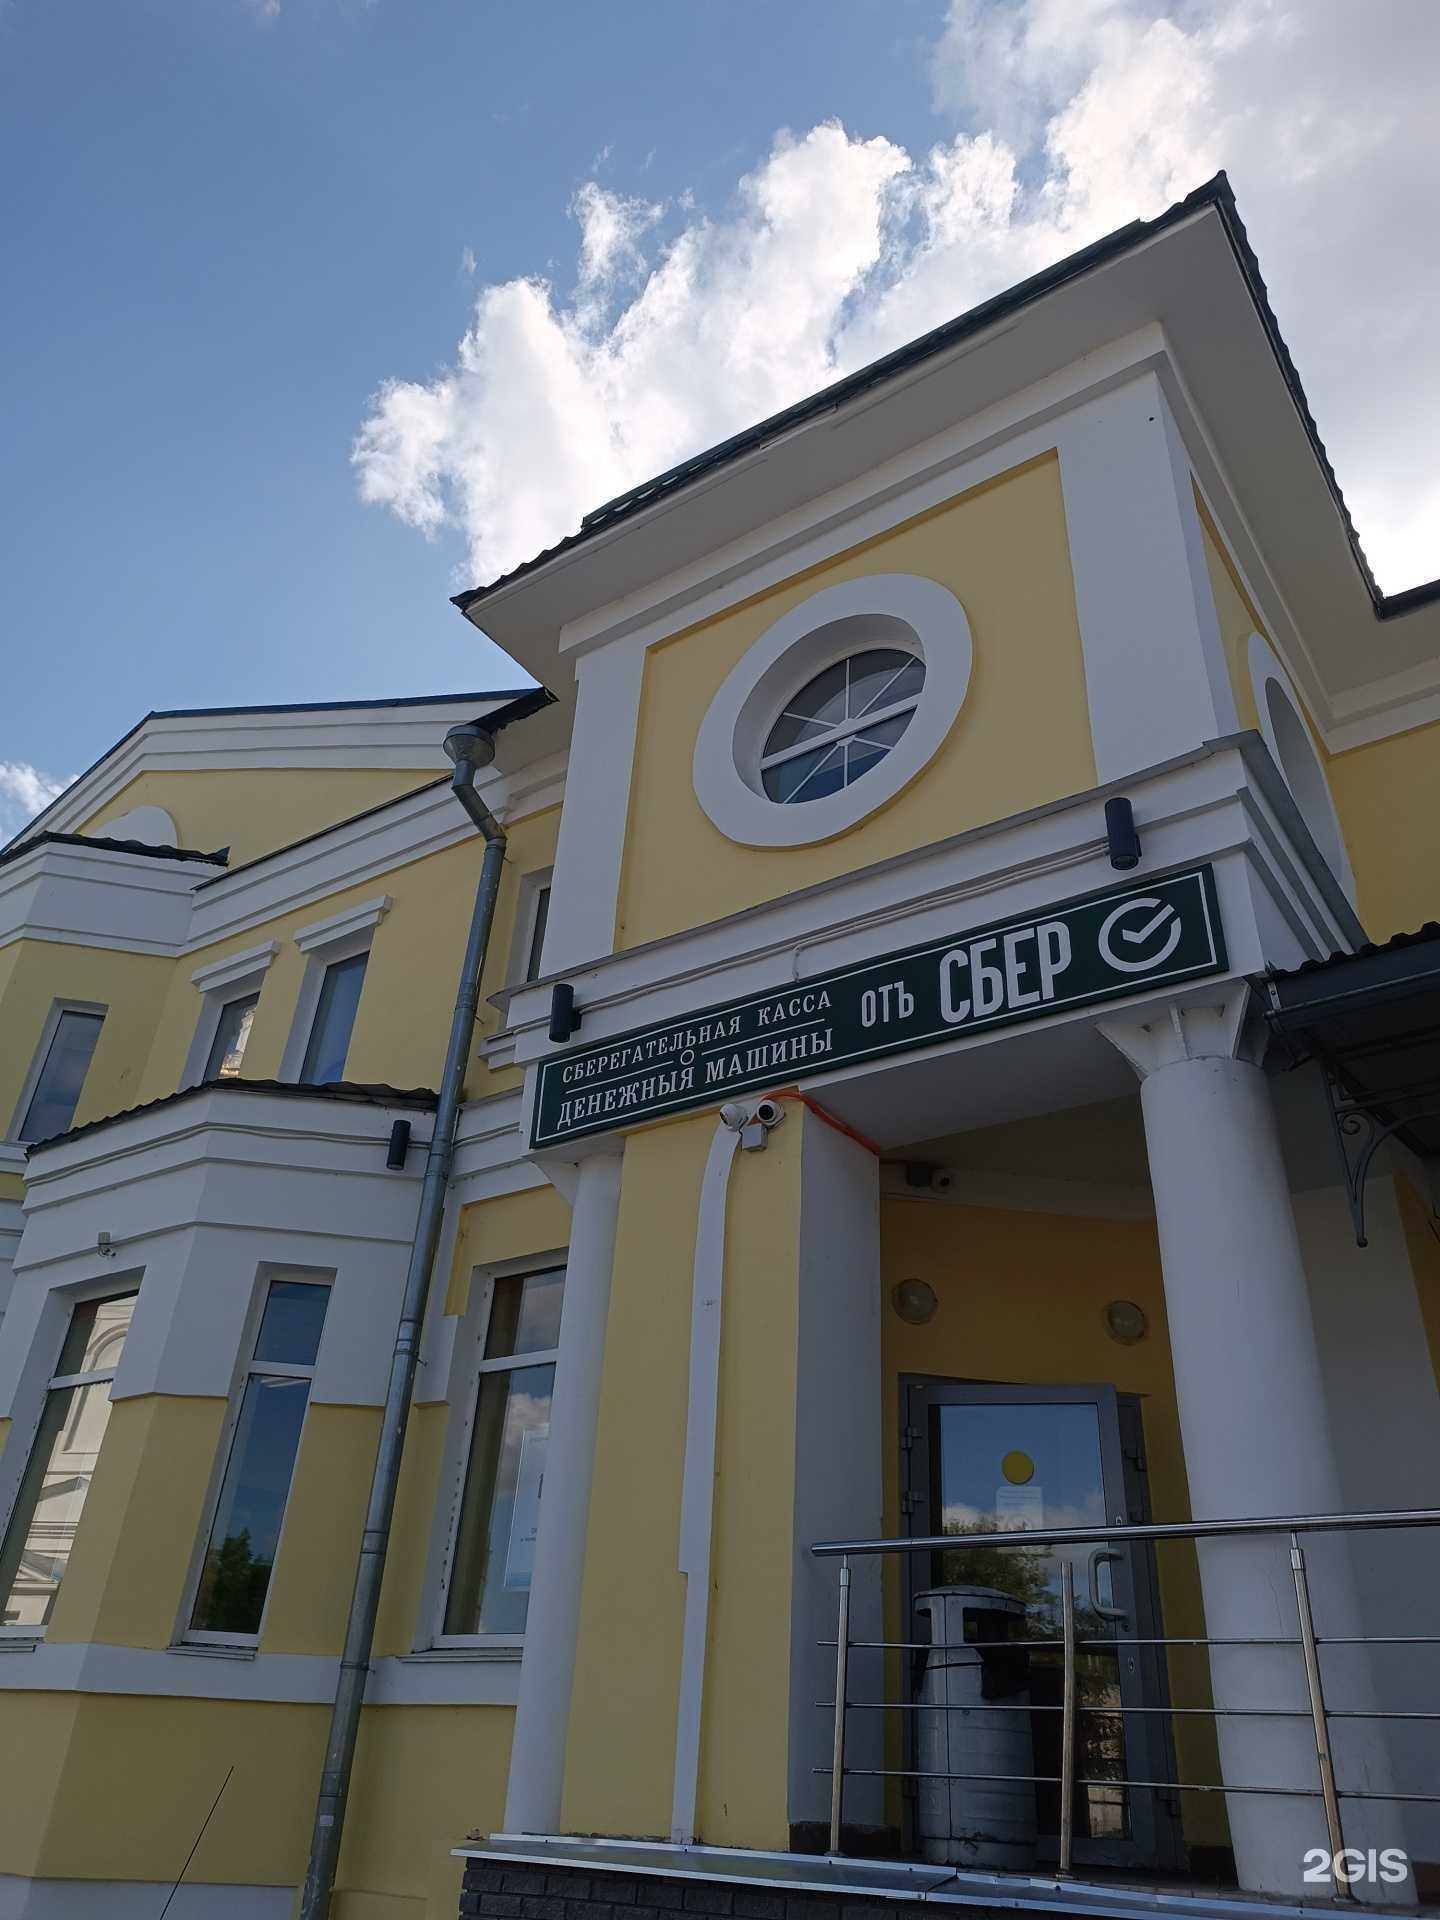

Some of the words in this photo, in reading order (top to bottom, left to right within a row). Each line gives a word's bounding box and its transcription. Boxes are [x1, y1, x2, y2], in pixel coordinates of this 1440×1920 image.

[861, 981, 915, 1028] ОТЪ
[939, 920, 1073, 1024] СБЕР
[556, 1066, 695, 1131] ДЕНЕЖНЫЯ
[704, 1028, 833, 1084] МАШИНЫ
[562, 1015, 742, 1083] СБЕРЕГАТЕЛЬНАЯ
[757, 990, 832, 1027] КАССА
